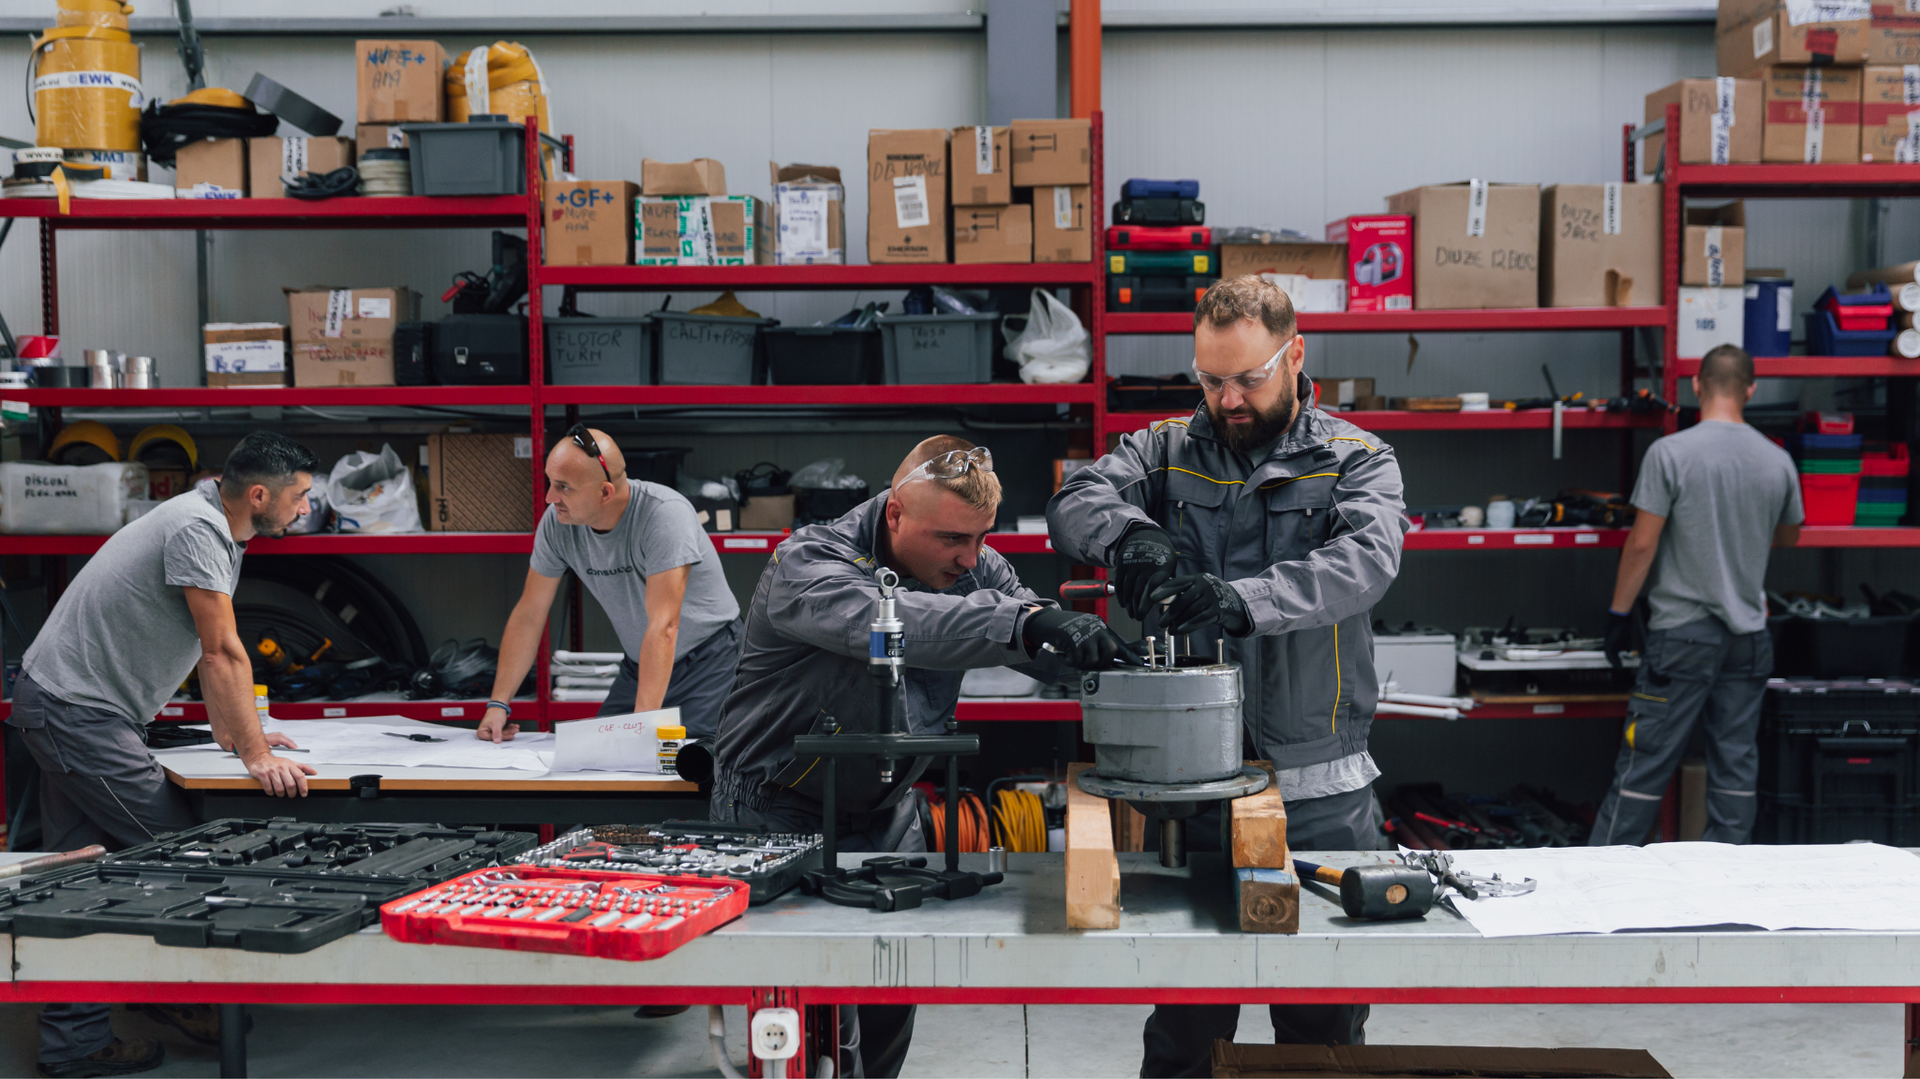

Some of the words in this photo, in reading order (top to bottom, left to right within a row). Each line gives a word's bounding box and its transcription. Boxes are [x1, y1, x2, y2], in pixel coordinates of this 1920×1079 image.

[79, 73, 114, 85] EWK
[555, 189, 614, 208] +GF+
[555, 329, 622, 347] FLOTOR
